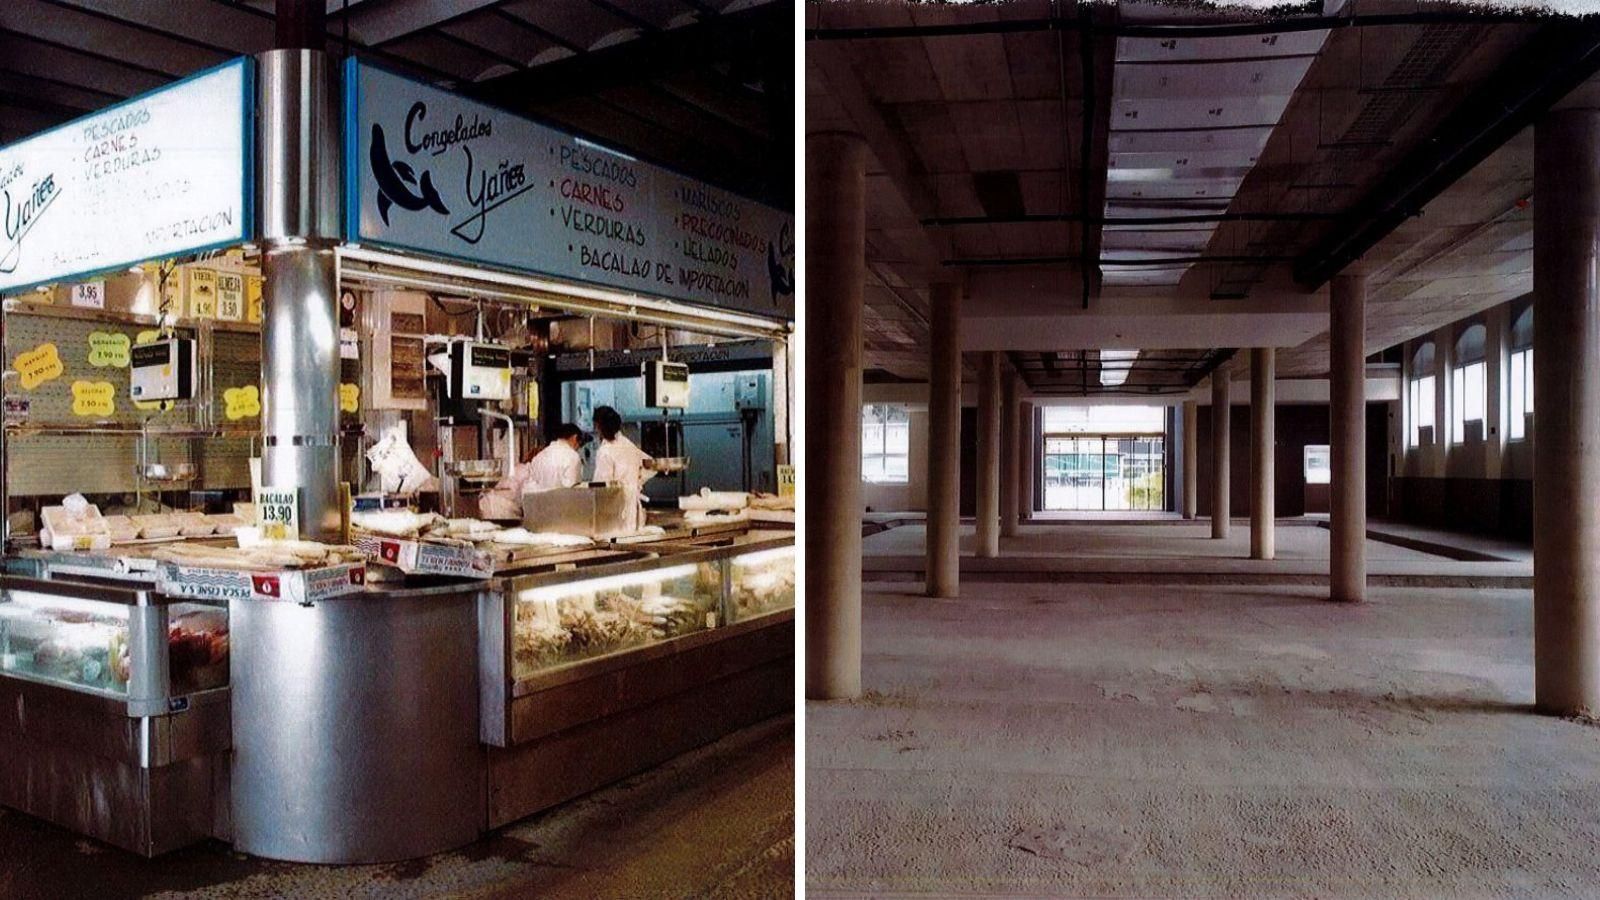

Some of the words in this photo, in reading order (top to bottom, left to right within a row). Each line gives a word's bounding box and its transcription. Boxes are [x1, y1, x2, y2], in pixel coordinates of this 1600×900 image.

[83, 107, 151, 142] PESCADOS
[405, 101, 493, 156] Congelados
[83, 132, 138, 163] CARNES
[84, 147, 162, 182] VERDURAS
[559, 145, 638, 189] PESCADOS
[560, 178, 625, 213] CARNES
[682, 187, 742, 221] MARISCOS
[560, 210, 646, 247] VERDURAS
[580, 244, 651, 280] BACALAO
[655, 258, 674, 284] DE
[679, 266, 750, 299] IMPORTACION
[259, 493, 295, 504] BACALAO
[262, 505, 292, 521] 13.90
